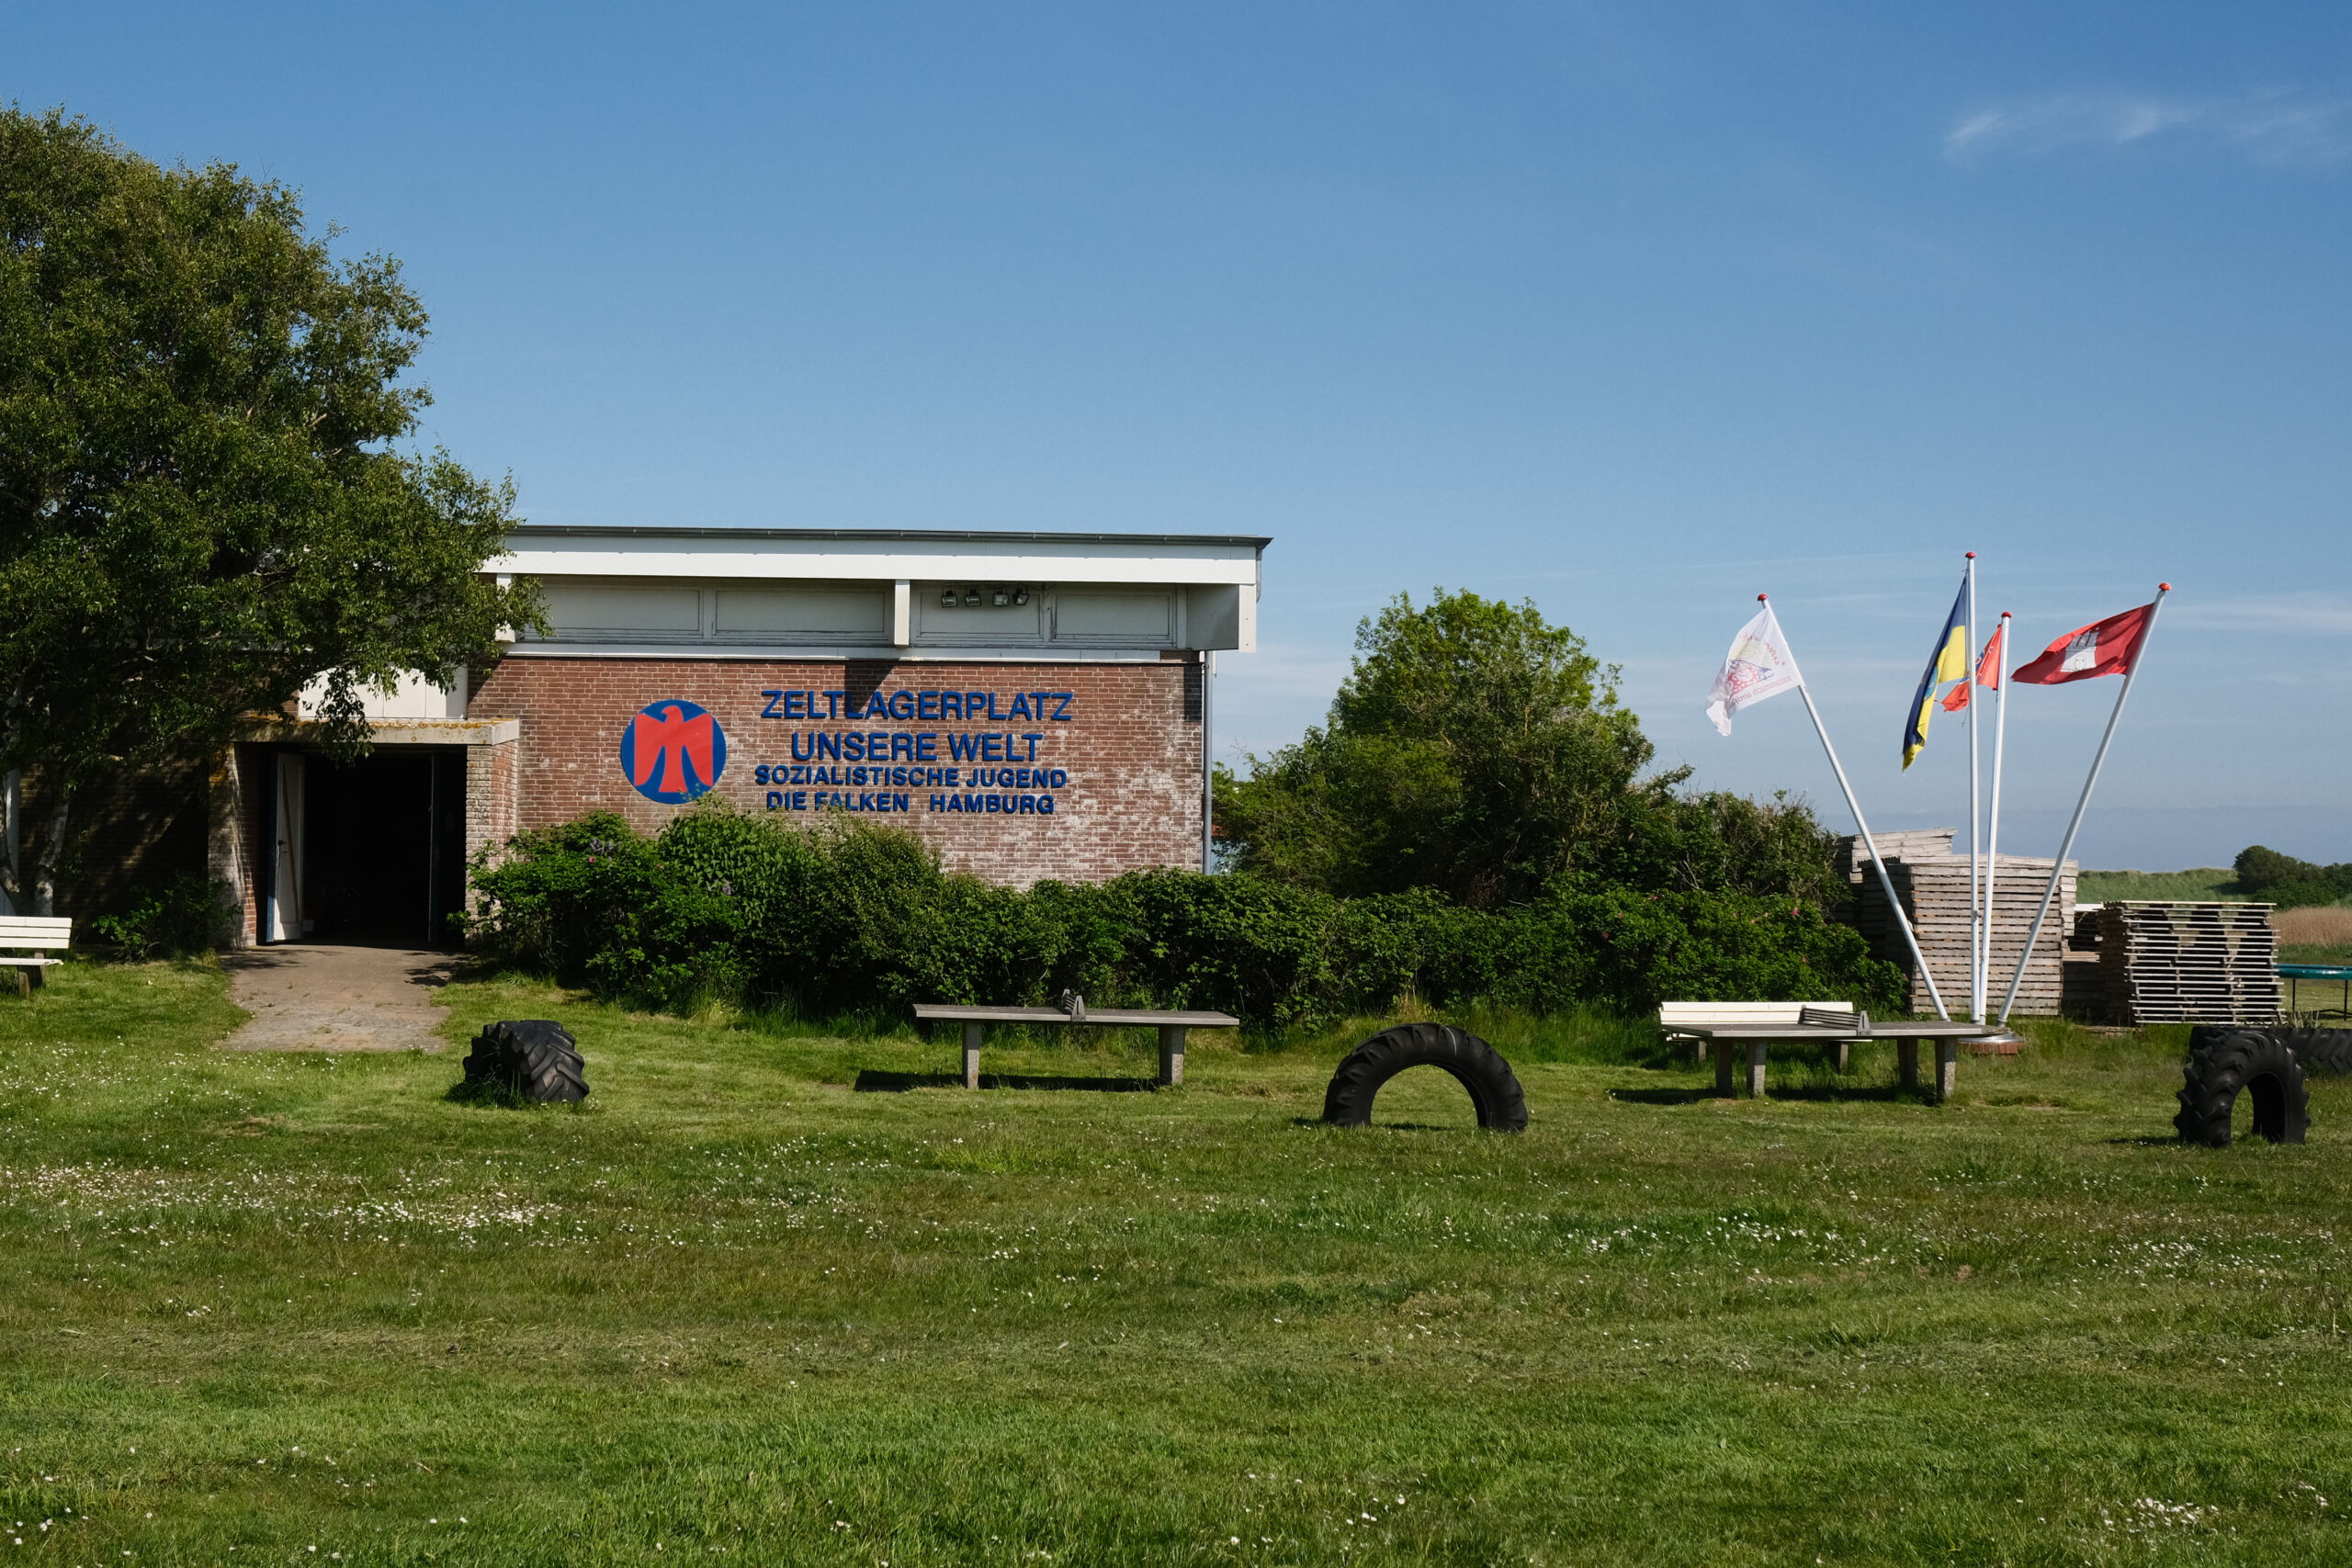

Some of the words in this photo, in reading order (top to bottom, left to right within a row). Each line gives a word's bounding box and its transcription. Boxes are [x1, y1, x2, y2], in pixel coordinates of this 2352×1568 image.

[761, 690, 1073, 721] ZELTLAGERPLATZ
[791, 731, 937, 761] UNSERE
[947, 732, 1044, 761] WELT
[754, 764, 959, 787] SOZIALISTISCHE
[966, 767, 1067, 788] JUGEND
[766, 791, 808, 811] DIE
[814, 791, 909, 812] FALKEN
[929, 793, 1055, 815] HAMBURG
